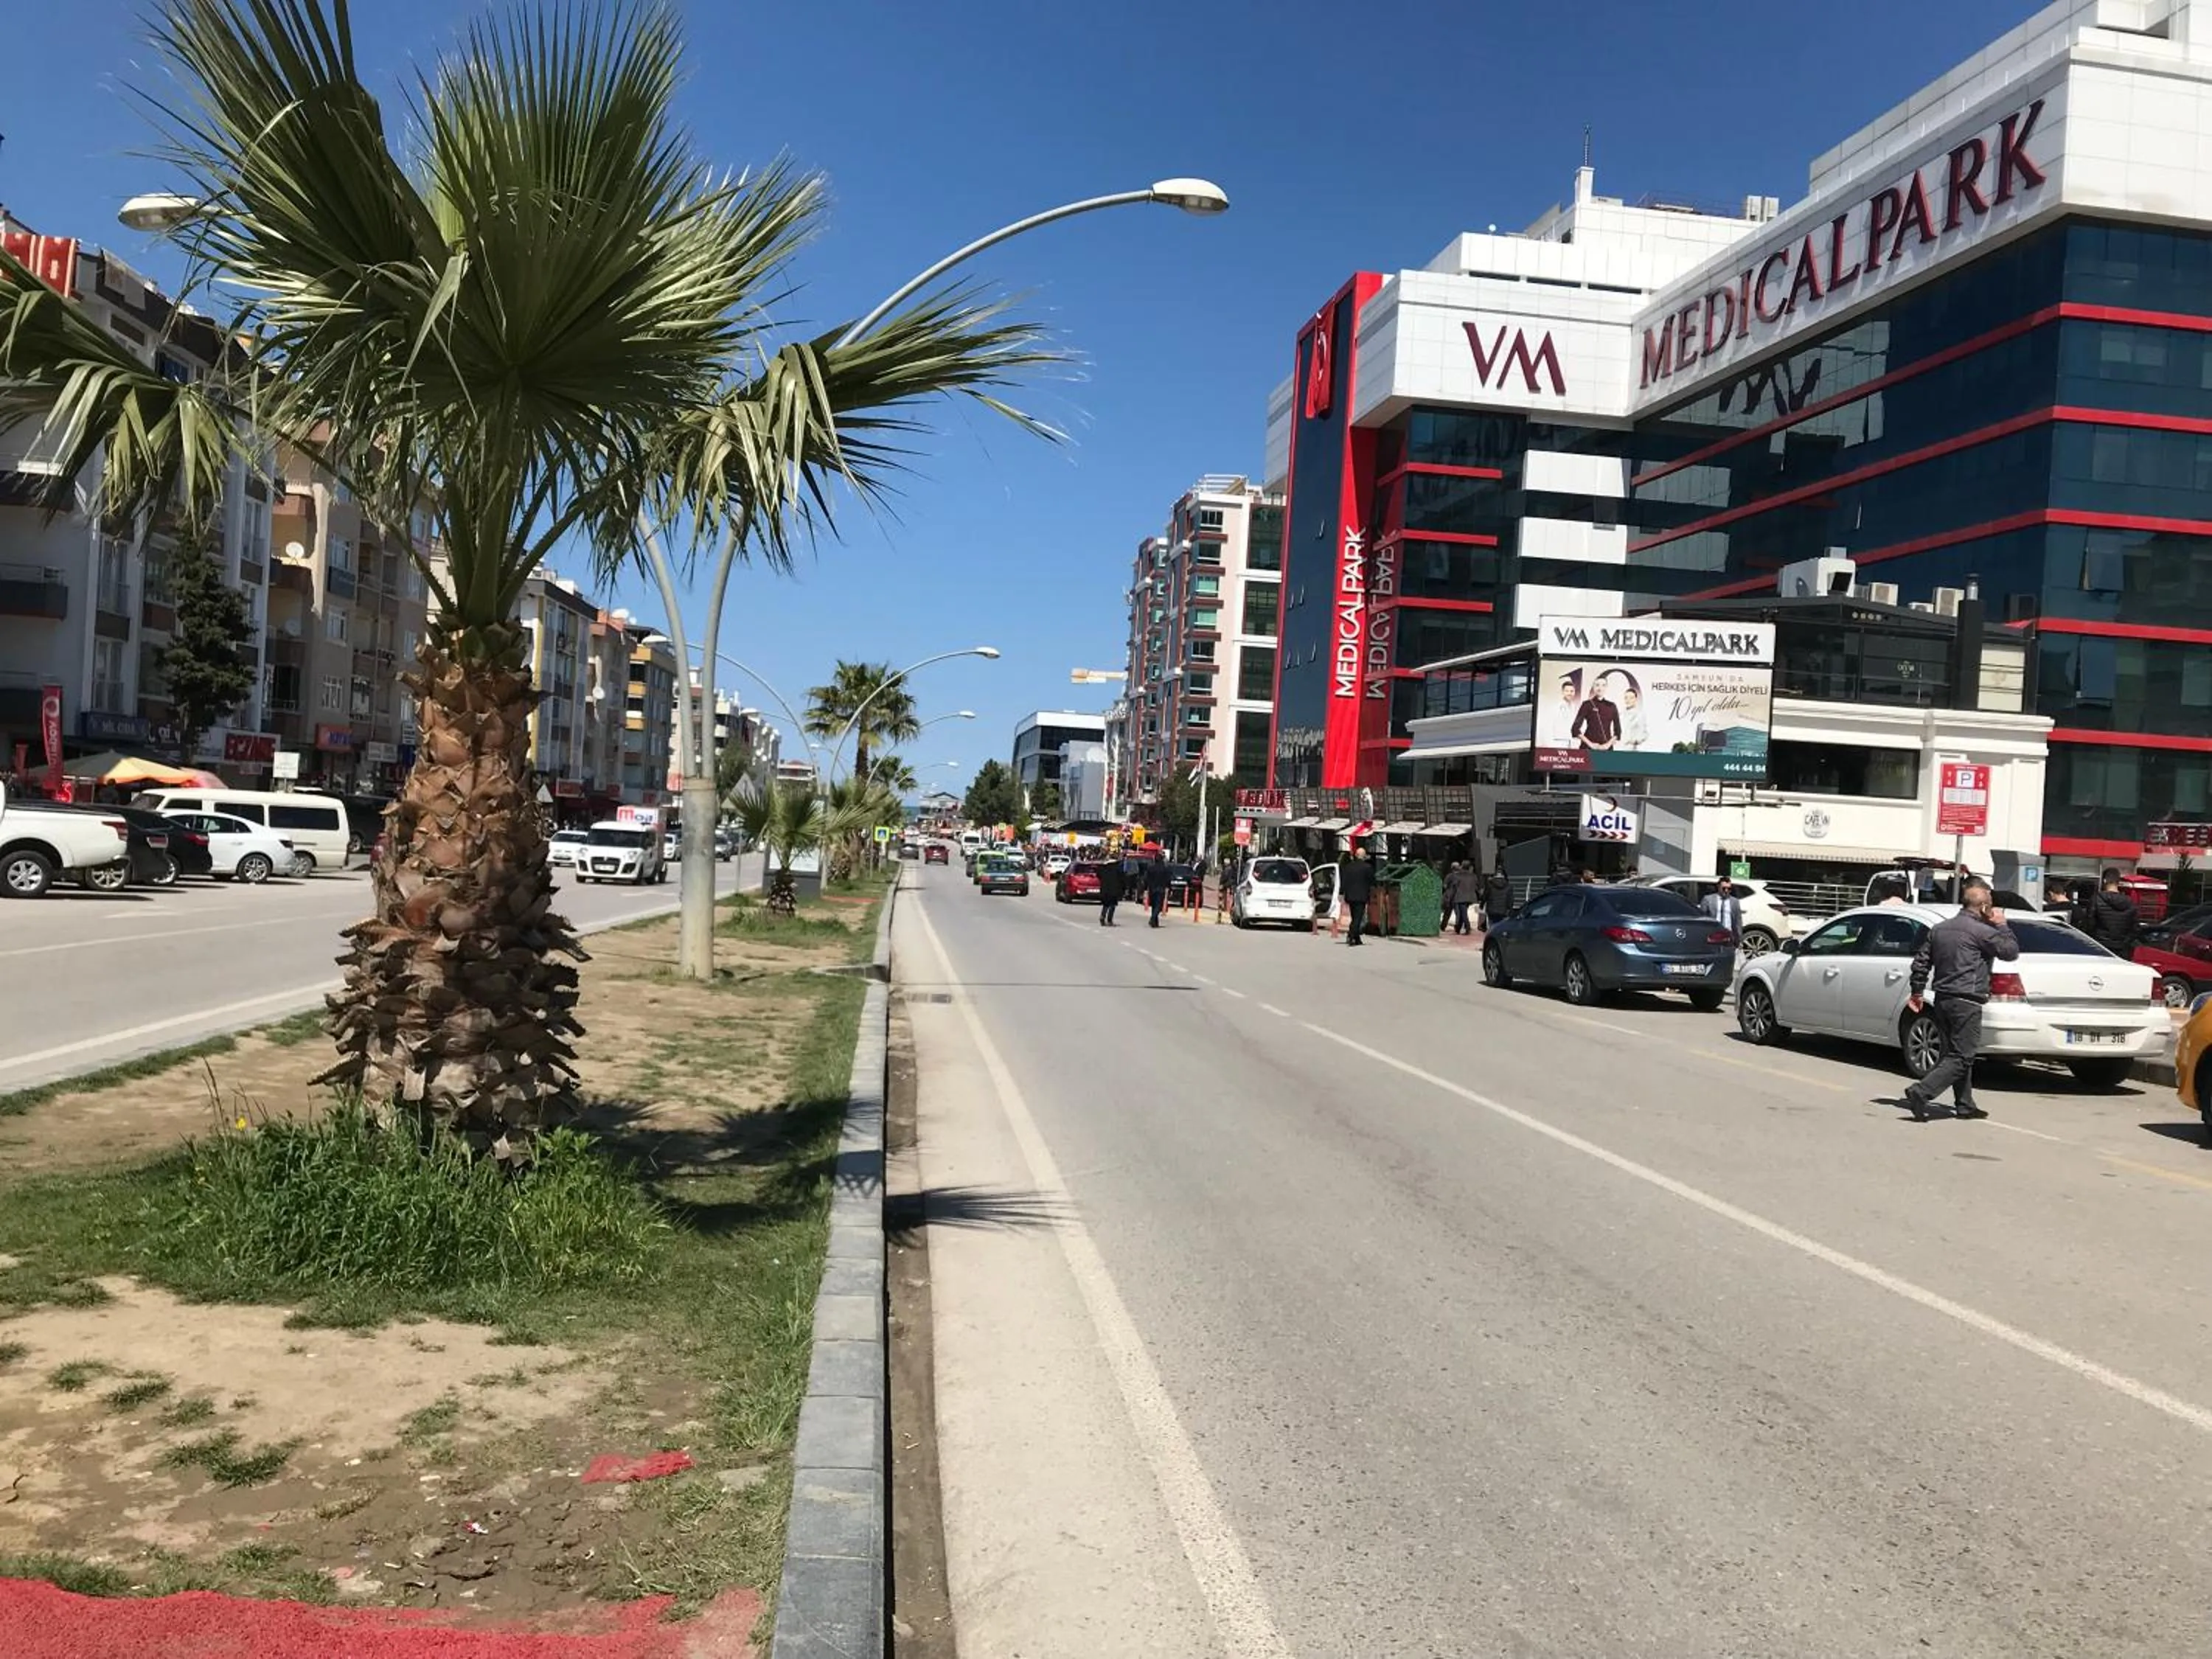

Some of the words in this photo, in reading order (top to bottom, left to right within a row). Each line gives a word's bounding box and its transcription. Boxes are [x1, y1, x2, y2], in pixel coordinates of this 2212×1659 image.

[1638, 99, 2048, 391] MEDICALPARK
[1462, 321, 1566, 397] VM
[1335, 524, 1367, 698] MEDICALPARK
[1554, 627, 1590, 649] VM
[1600, 628, 1760, 655] MEDICALPARK
[1652, 682, 1686, 692] HERKES
[1707, 684, 1739, 695] SAĞLIK
[1739, 685, 1768, 695] DİYELİ
[1669, 696, 1692, 720] 10
[1587, 813, 1632, 832] ACİL
